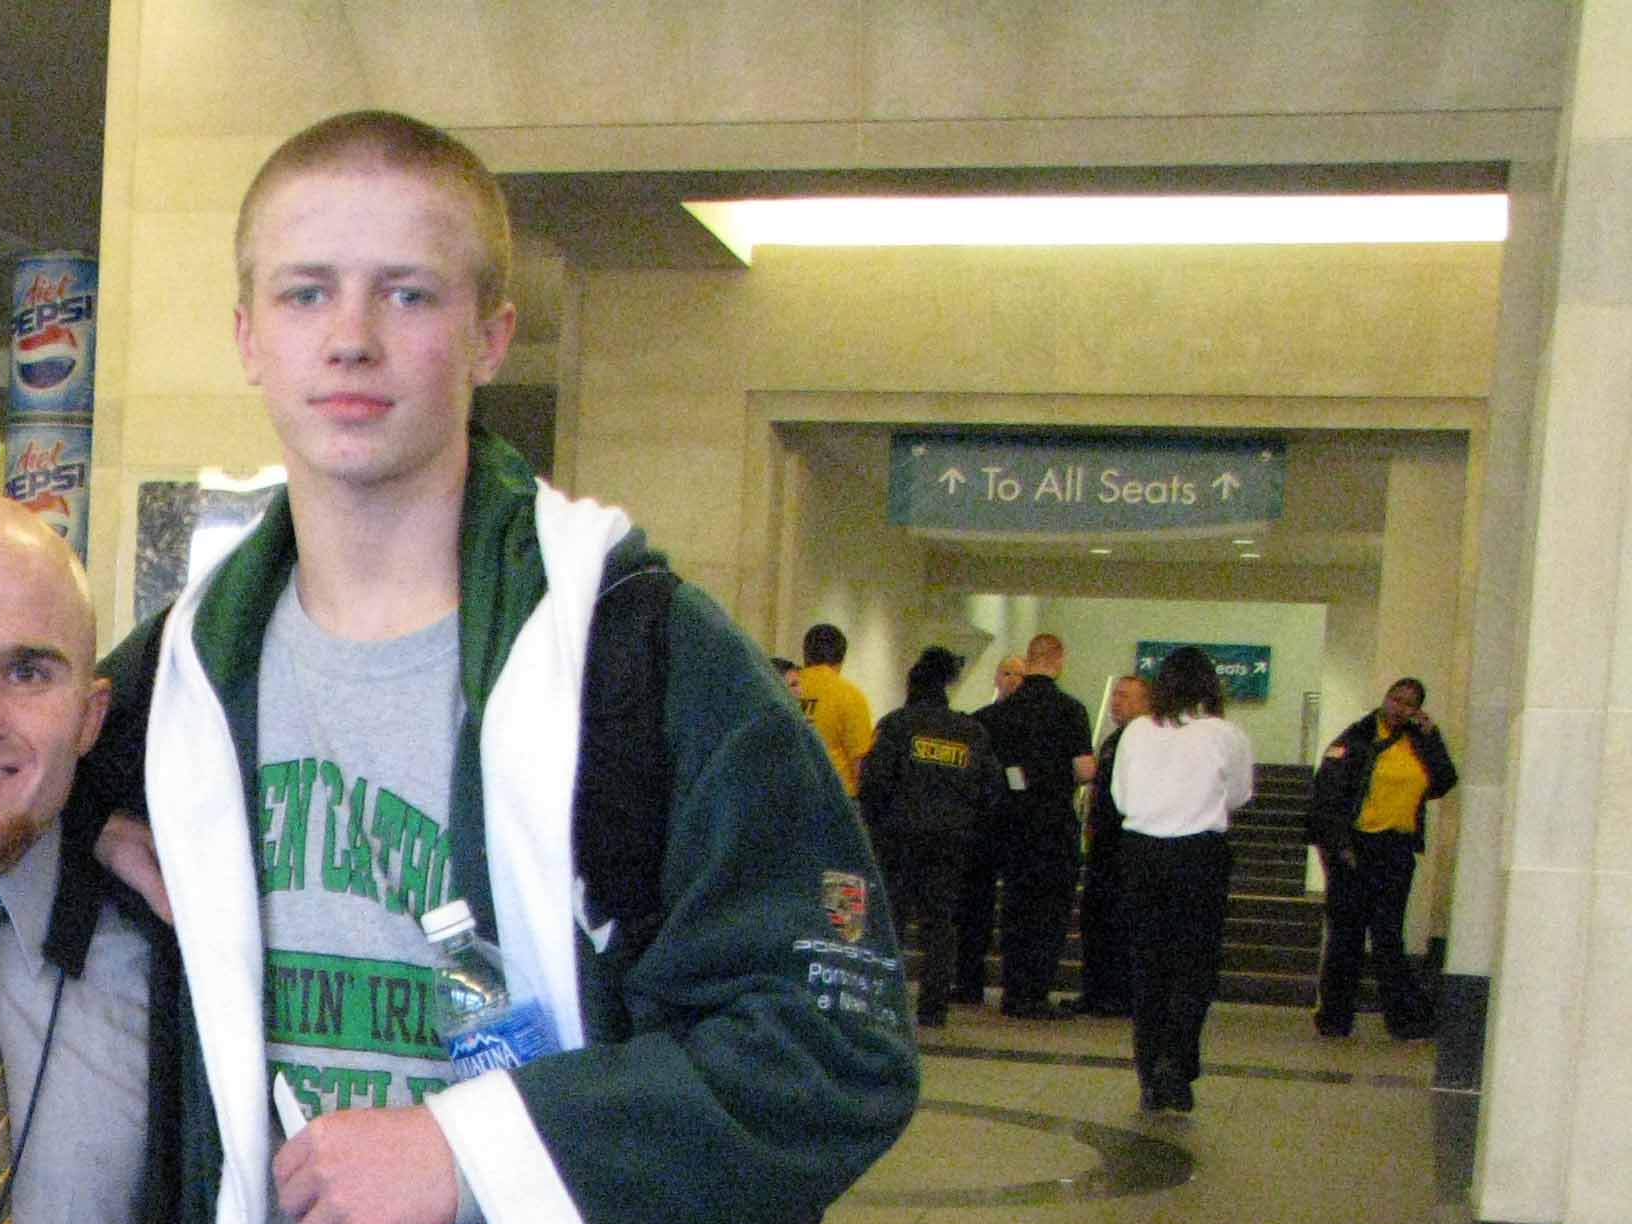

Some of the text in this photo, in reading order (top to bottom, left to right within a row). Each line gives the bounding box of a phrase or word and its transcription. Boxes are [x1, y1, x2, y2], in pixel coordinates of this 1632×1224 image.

[981, 467, 1197, 505] To All Seats
[1210, 659, 1248, 677] eats
